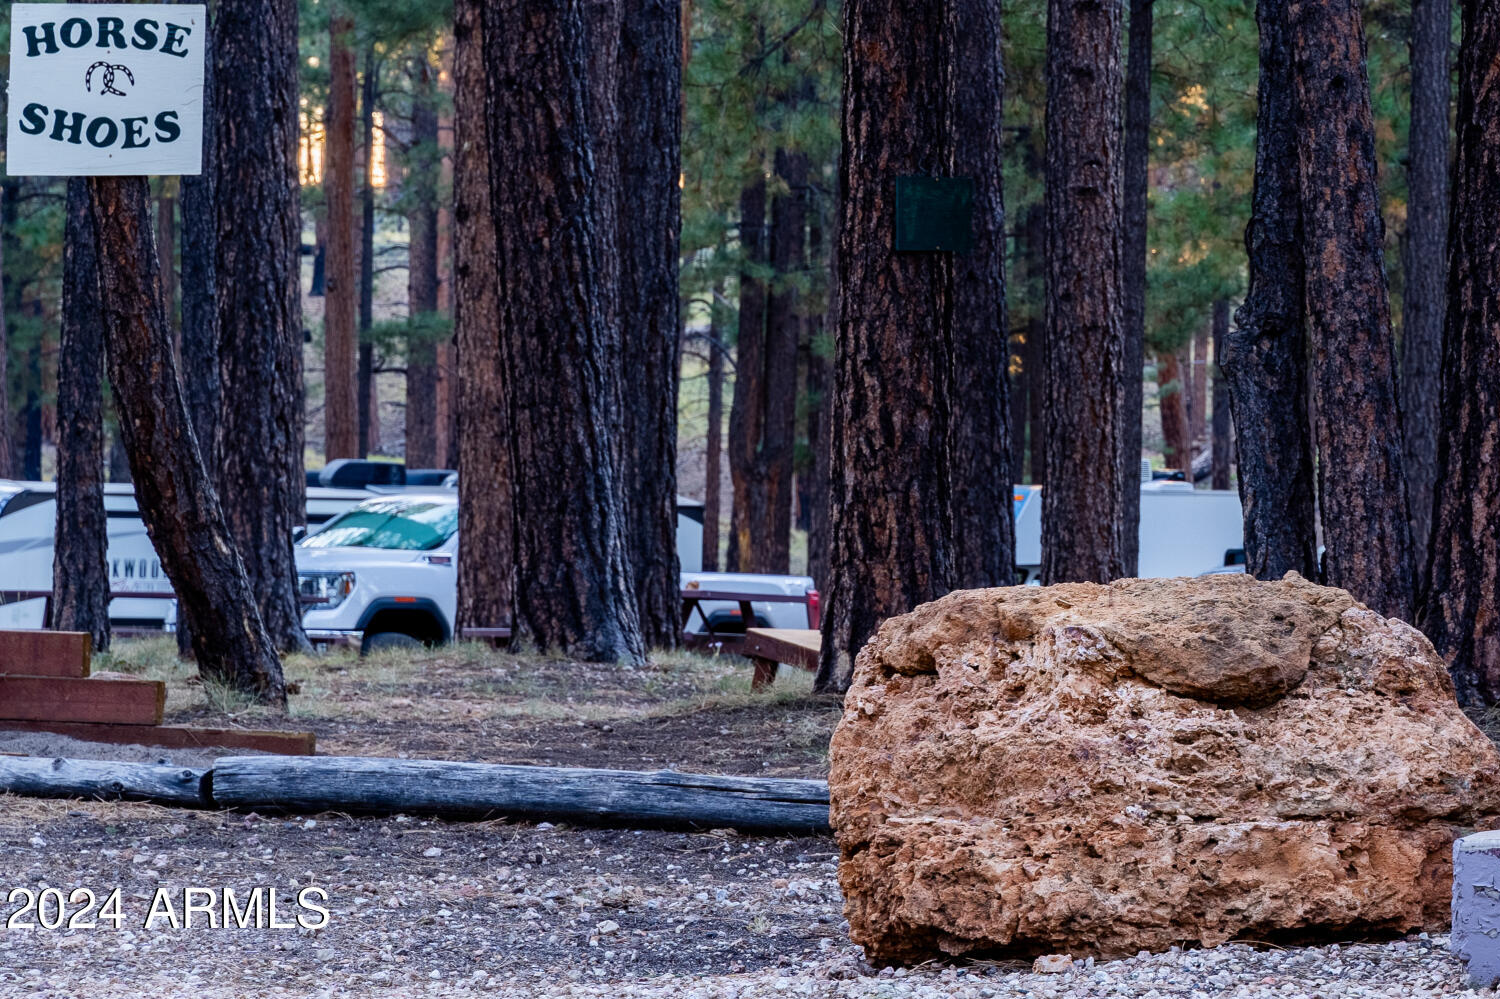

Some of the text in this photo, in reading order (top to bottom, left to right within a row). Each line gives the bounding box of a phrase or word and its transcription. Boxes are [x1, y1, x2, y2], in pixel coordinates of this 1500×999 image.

[22, 16, 192, 58] HORSE
[19, 102, 182, 149] SHOES
[112, 558, 167, 578] KWOO
